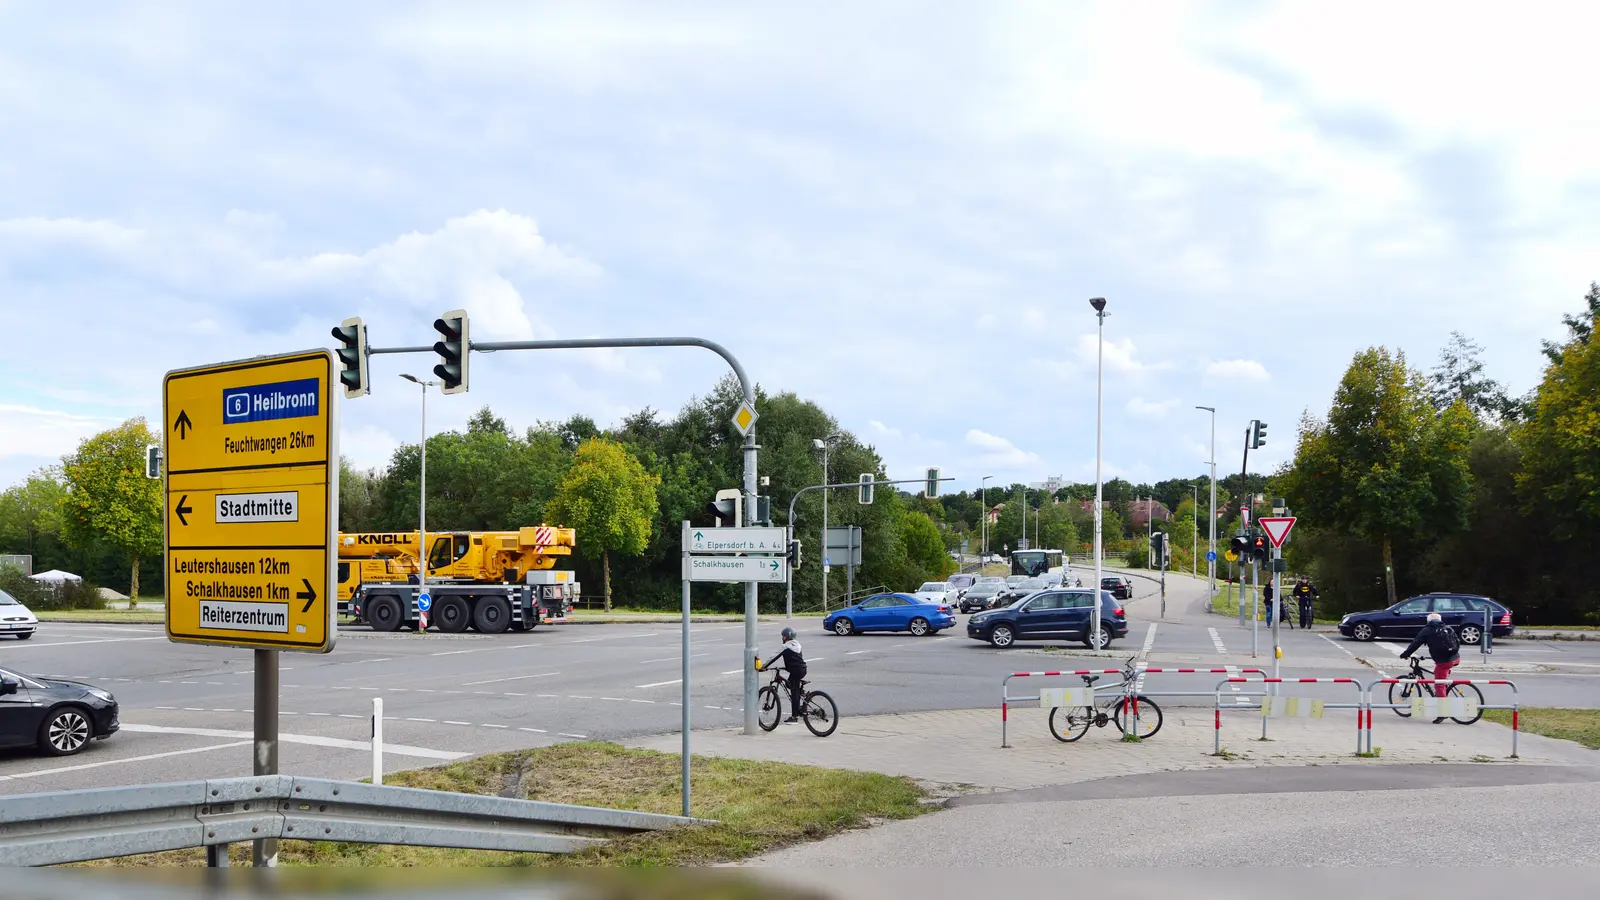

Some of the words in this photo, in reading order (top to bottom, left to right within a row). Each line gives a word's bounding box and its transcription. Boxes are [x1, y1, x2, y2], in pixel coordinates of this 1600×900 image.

[235, 399, 241, 412] 6
[253, 391, 315, 412] Heilbronn
[225, 434, 287, 454] Feuchtwangen
[289, 431, 315, 449] 26km
[220, 499, 293, 517] Stadtmitte
[358, 534, 412, 545] KNOLL
[707, 541, 746, 550] Elpersdorf
[174, 557, 255, 575] Leutershausen
[258, 557, 290, 575] 12km
[693, 560, 744, 568] Schalkhausen
[186, 580, 263, 599] Schalkhausen
[266, 582, 290, 600] 1km
[202, 605, 285, 626] Reiterzentrum
